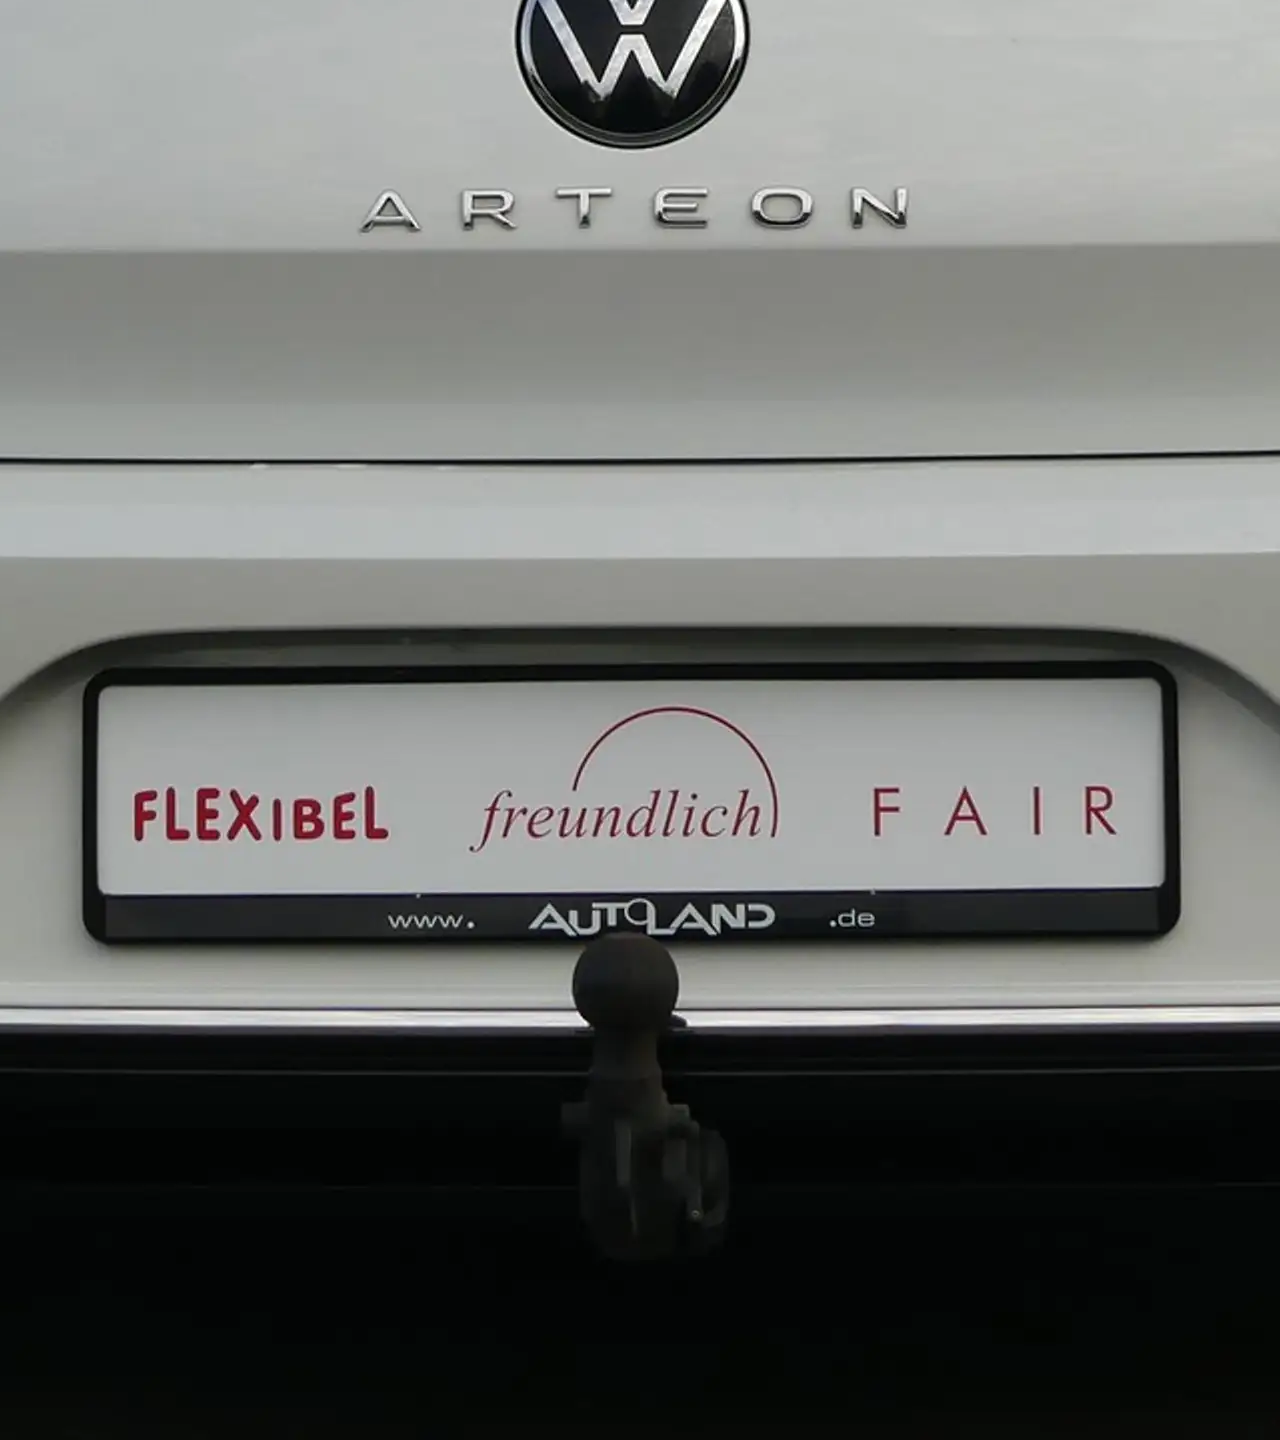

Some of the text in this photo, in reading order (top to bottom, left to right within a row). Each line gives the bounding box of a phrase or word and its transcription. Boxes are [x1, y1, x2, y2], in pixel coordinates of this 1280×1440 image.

[359, 186, 910, 233] ARTEON
[132, 785, 1118, 853] FLEXIBEL freundlich FAIR
[387, 914, 475, 929] www.
[828, 907, 876, 928] .de
